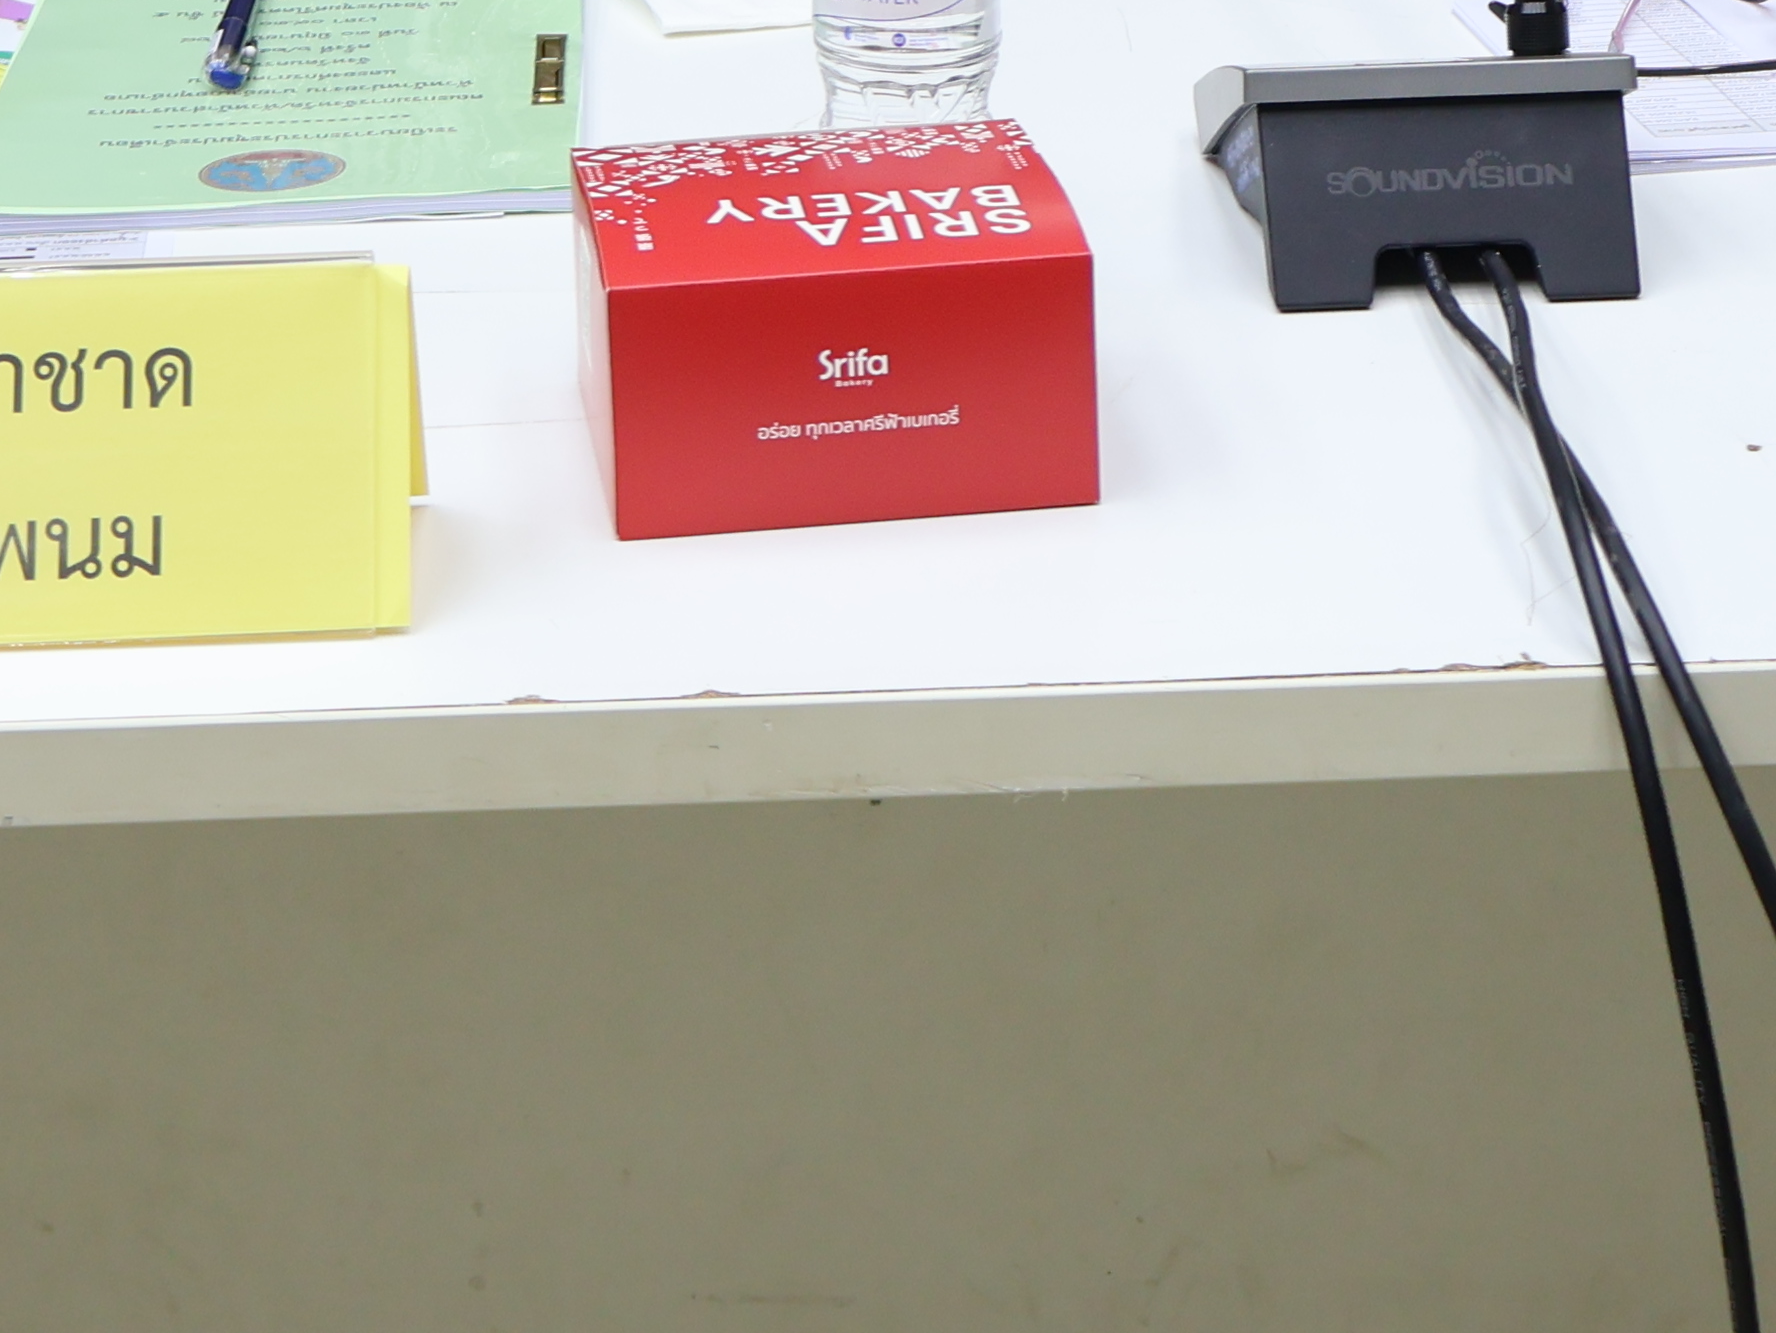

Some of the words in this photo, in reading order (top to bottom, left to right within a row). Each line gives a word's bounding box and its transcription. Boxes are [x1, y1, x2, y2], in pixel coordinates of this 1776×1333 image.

[1326, 155, 1574, 198] SOUNDVISION
[706, 184, 1020, 224] BAKERY
[795, 207, 1032, 246] SRIFA
[818, 346, 889, 380] Srifa
[833, 379, 874, 388] Bakery
[756, 421, 801, 440] อร่อย
